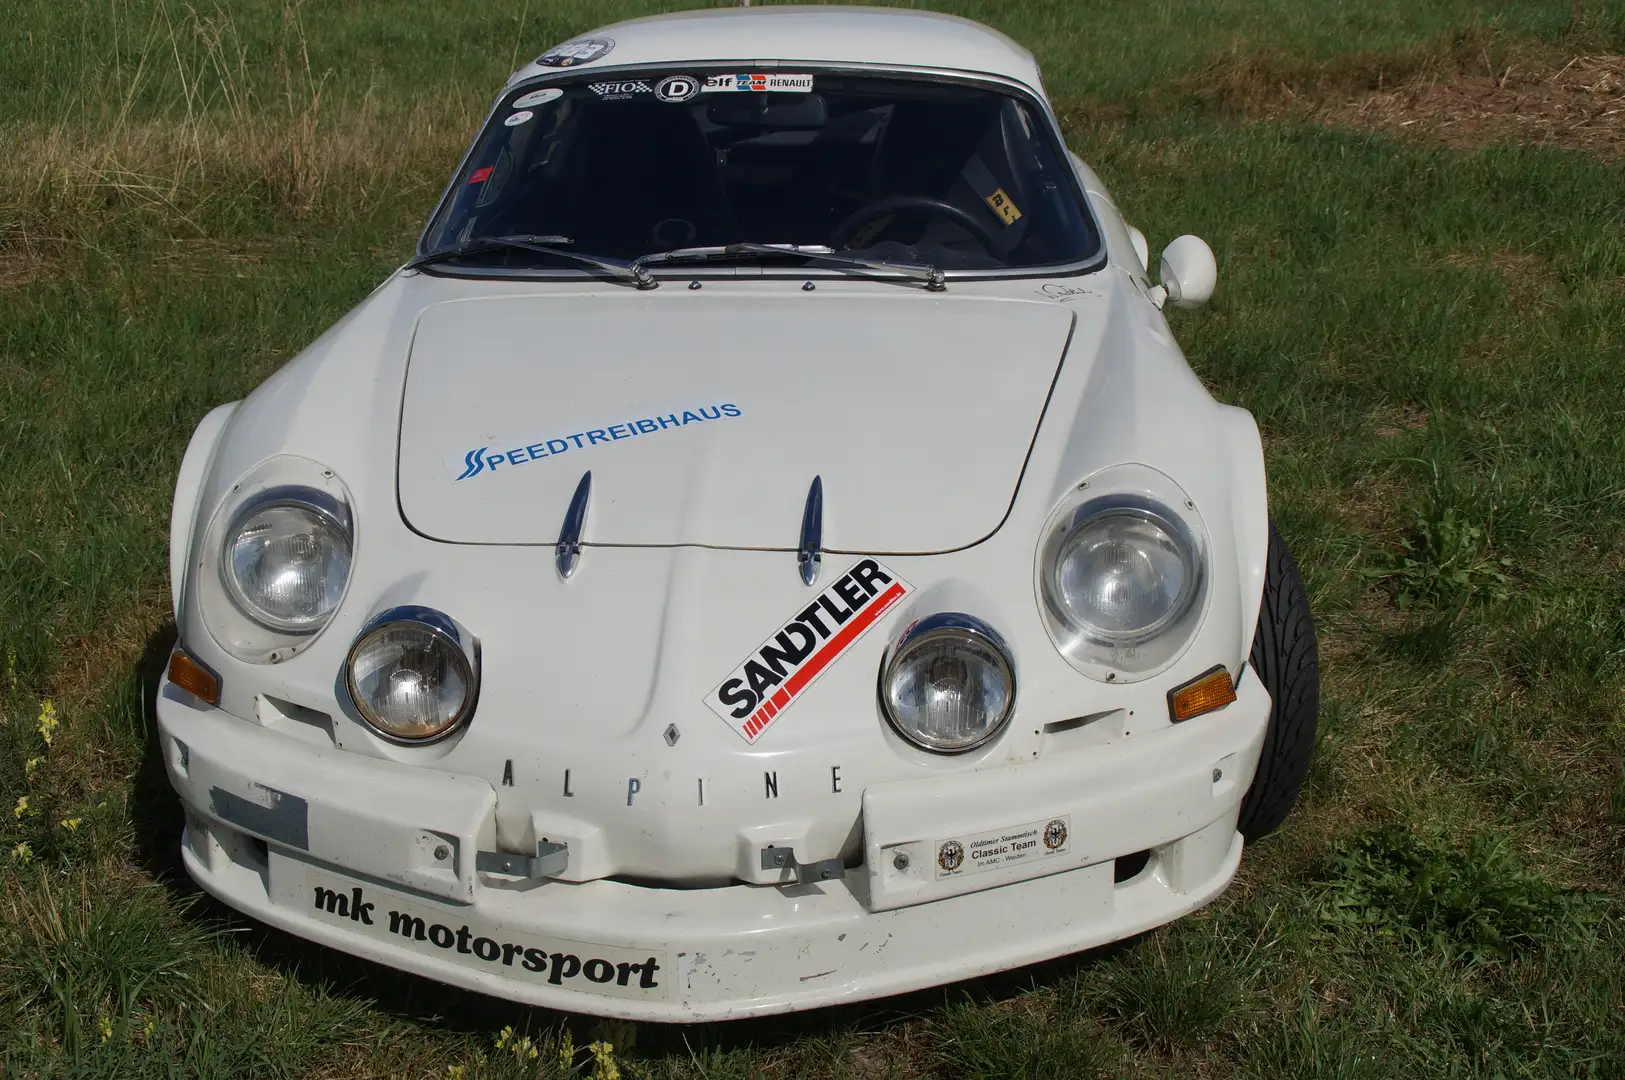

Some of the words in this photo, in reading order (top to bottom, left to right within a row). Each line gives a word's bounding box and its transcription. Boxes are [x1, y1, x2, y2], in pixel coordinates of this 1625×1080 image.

[604, 82, 637, 94] FIO
[668, 81, 689, 97] D
[705, 77, 733, 87] elf
[770, 79, 812, 88] RENAULT
[455, 403, 742, 481] SPEEDTREIBHAUS
[718, 559, 893, 719] SANDTLER
[501, 759, 842, 806] ALPINE
[970, 838, 1000, 849] Oldtimer
[1000, 829, 1038, 842] Stammtisch
[971, 845, 1009, 860] Classic
[1011, 839, 1037, 852] Team
[313, 886, 375, 925] mk
[388, 909, 660, 989] motorsport
